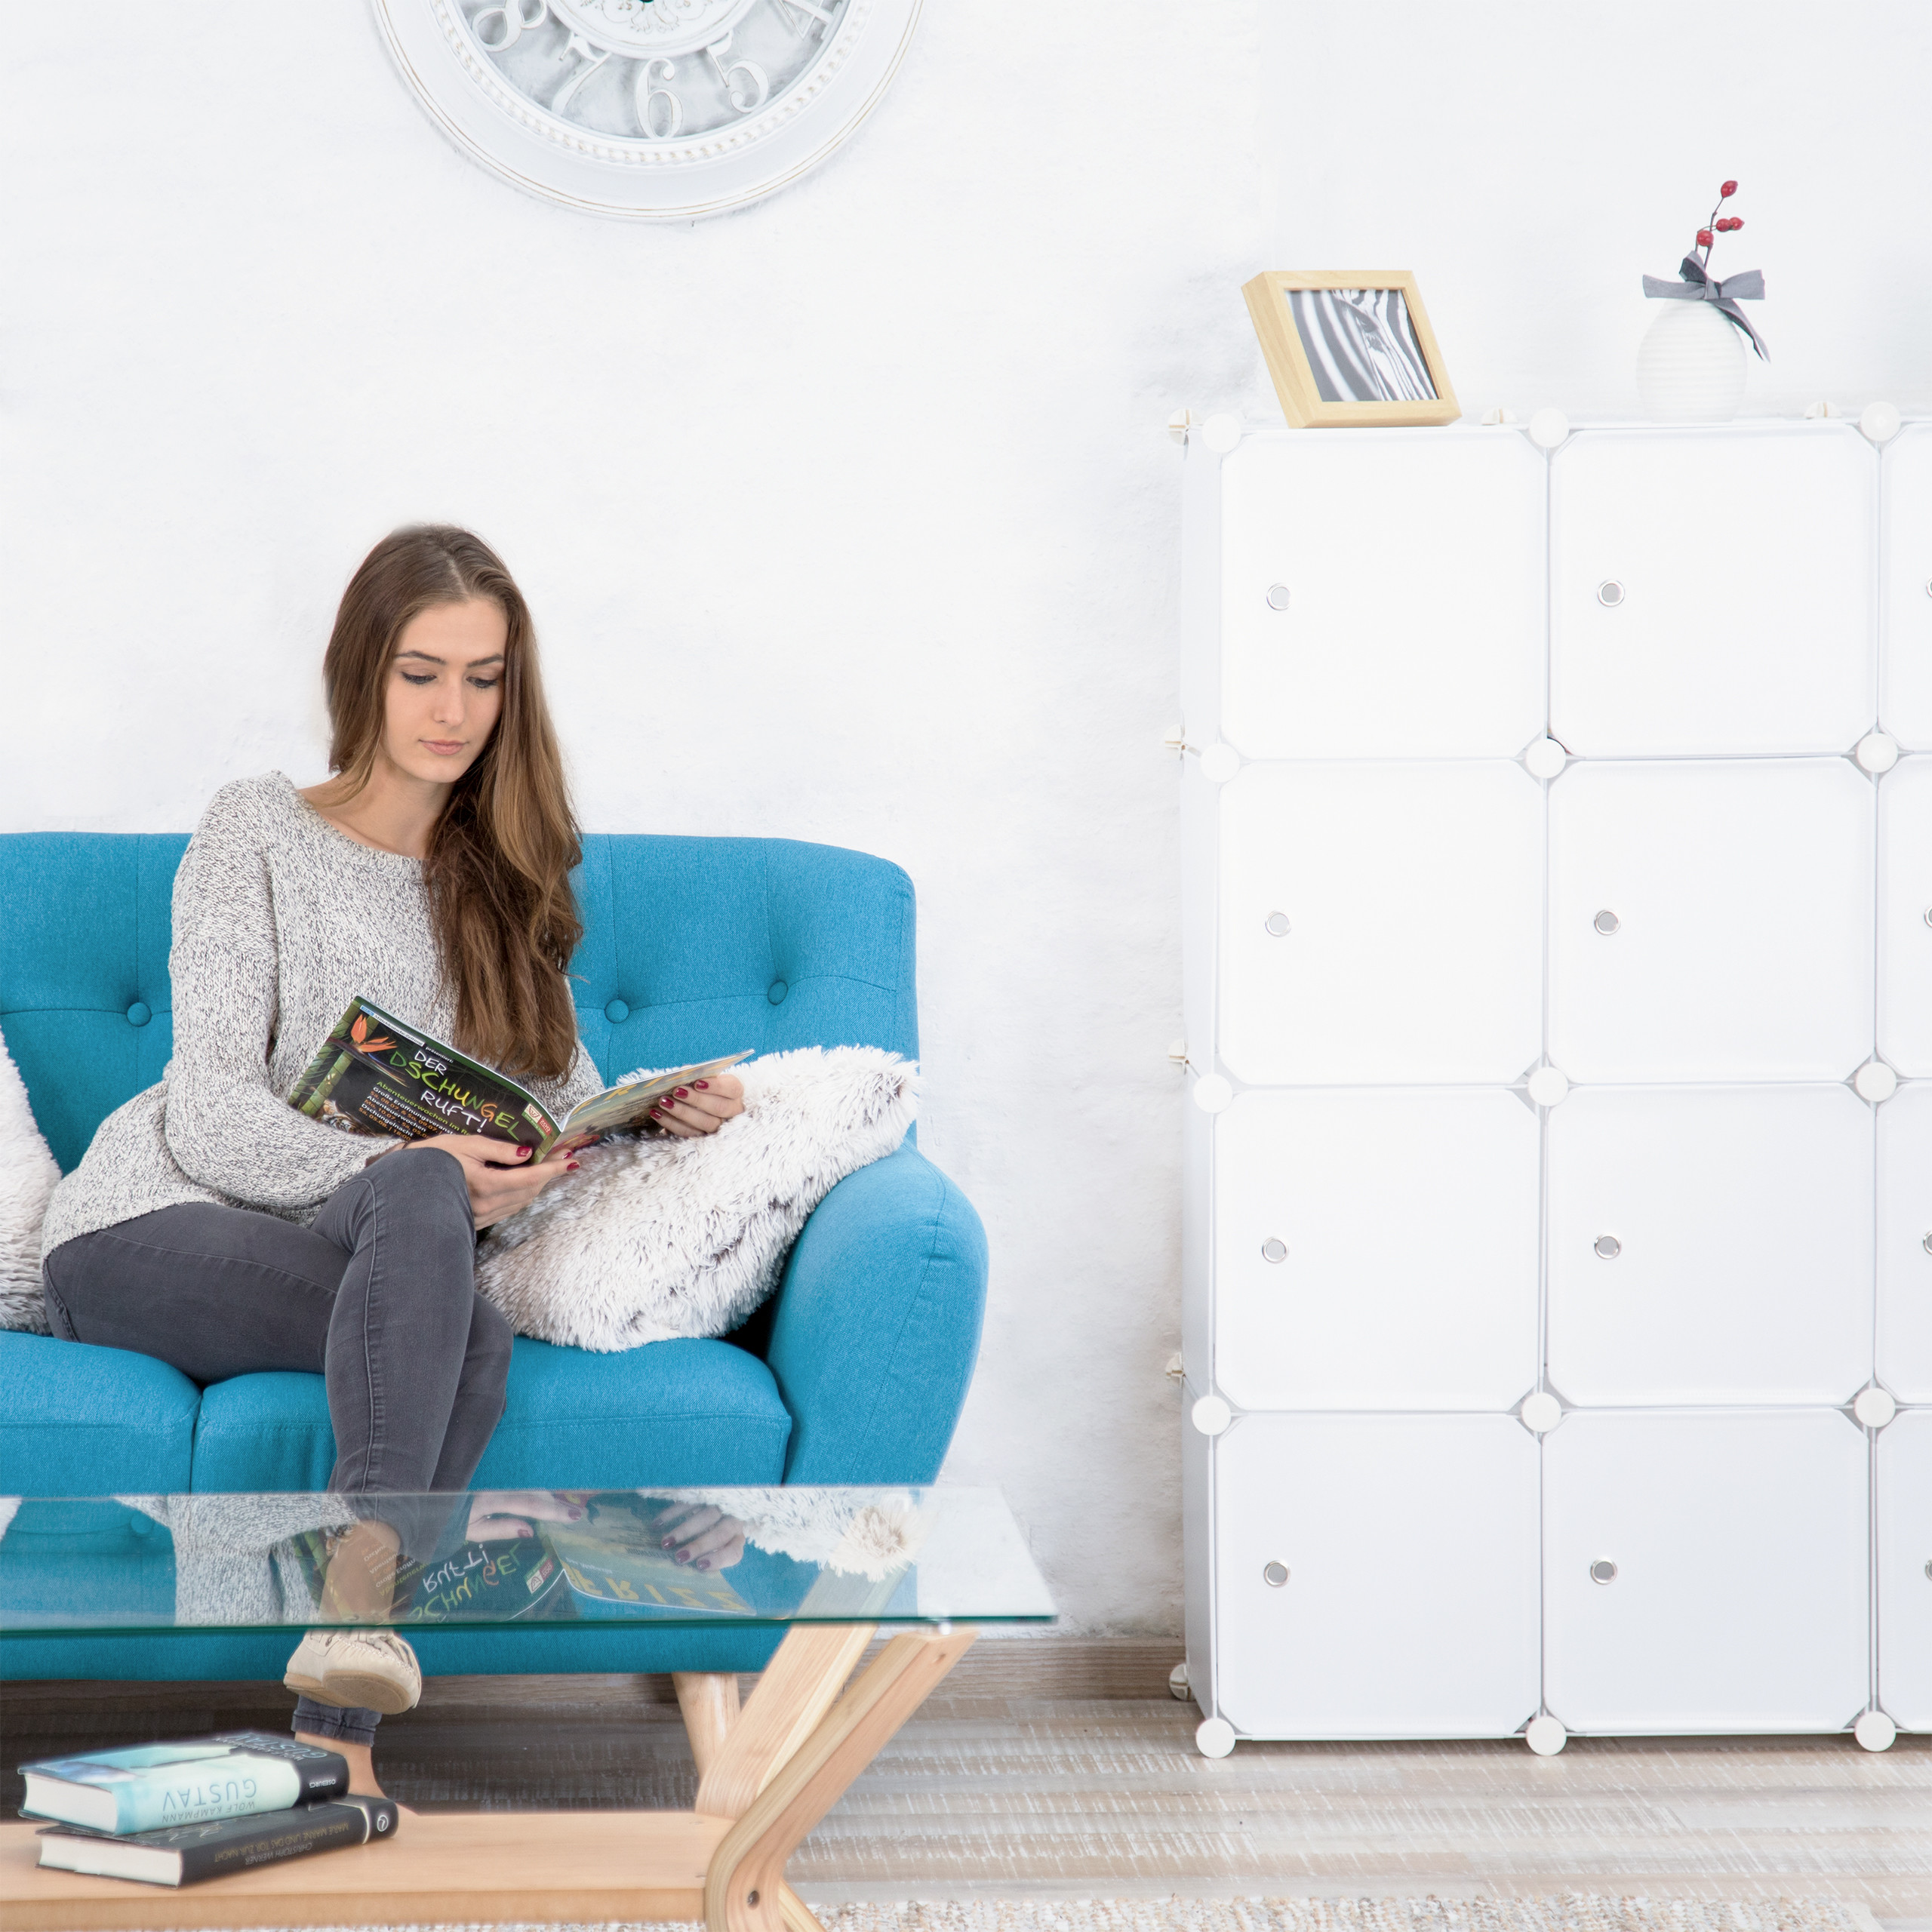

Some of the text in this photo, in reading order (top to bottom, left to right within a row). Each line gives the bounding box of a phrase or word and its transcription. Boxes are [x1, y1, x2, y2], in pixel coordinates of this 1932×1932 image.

[472, 0, 547, 53] 8
[551, 30, 613, 114] 7
[706, 29, 769, 113] 5
[635, 57, 683, 139] 6
[414, 1050, 447, 1076] DER
[373, 1087, 455, 1135] Große Eröffnungsveranst
[377, 1081, 448, 1125] Abenteuerwochen
[449, 1122, 460, 1131] im
[389, 1051, 520, 1142] DSCHUNGEL
[361, 1103, 414, 1137] Dschungelnacht
[367, 1095, 426, 1132] Abenteuerwochen
[420, 1090, 488, 1133] RUFT!
[412, 1128, 429, 1140] 05.0
[226, 1733, 328, 1759] GUSTAV
[163, 1779, 257, 1811] GUSTAV
[162, 1801, 255, 1823] WOLF KAMPMANN
[286, 1834, 302, 1845] UND
[329, 1822, 349, 1832] MARIE
[214, 1849, 238, 1863] NACHT
[240, 1843, 254, 1855] ZUR
[245, 1842, 313, 1866] CHRISTOPH WERNER
[256, 1840, 269, 1851] TOR
[271, 1837, 285, 1849] DAS
